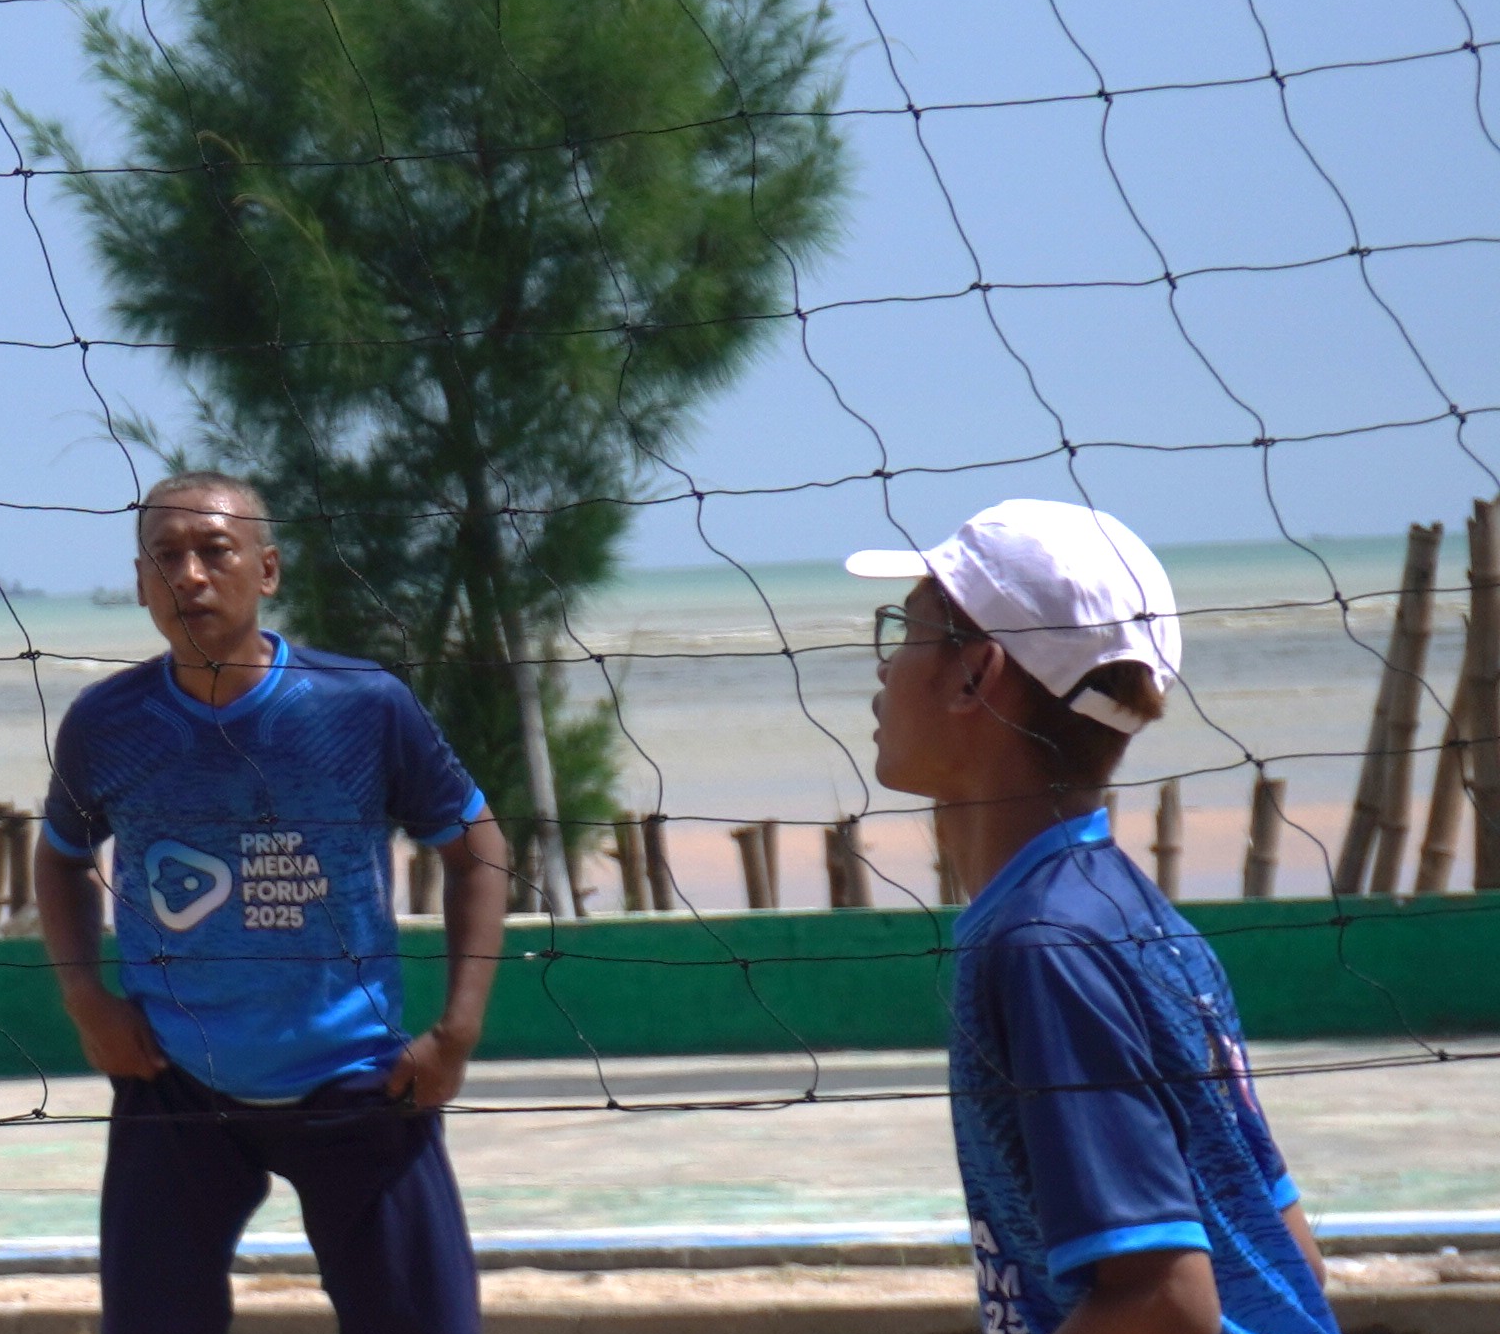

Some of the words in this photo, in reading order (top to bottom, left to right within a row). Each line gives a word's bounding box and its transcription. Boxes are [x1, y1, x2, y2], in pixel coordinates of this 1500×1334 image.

[240, 831, 303, 854] PRPP
[241, 854, 321, 877] MEDIA
[243, 876, 329, 903] FORUM
[244, 904, 304, 928] 2025
